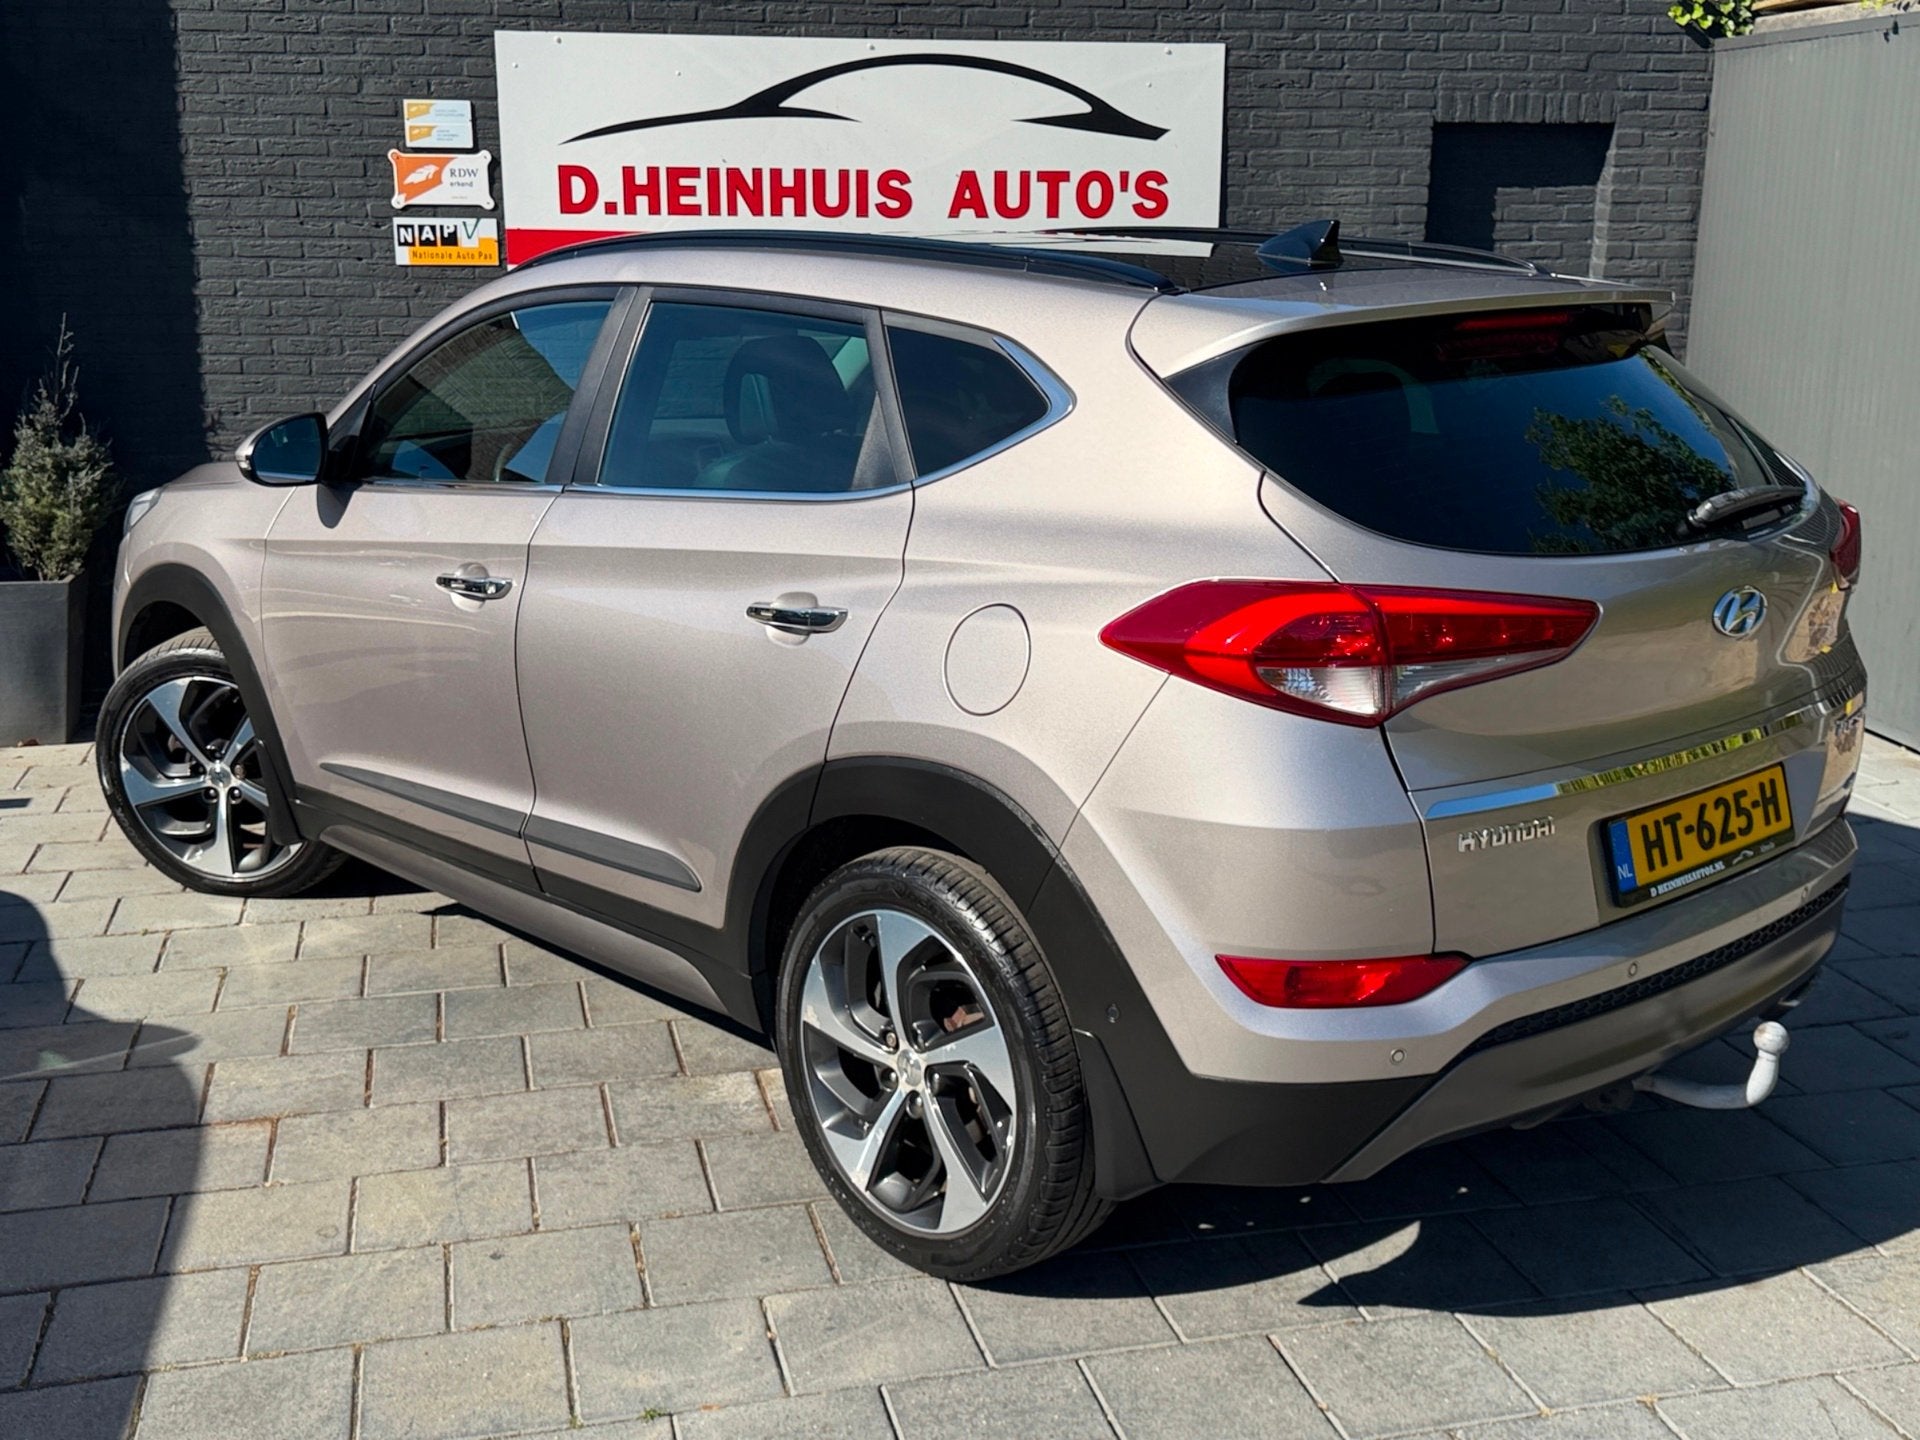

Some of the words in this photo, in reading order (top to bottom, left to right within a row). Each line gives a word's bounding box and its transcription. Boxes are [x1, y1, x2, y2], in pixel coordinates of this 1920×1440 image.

[449, 168, 479, 178] RDW
[557, 164, 913, 219] D.HEINHUIS
[948, 169, 1170, 220] AUTO'S
[412, 250, 453, 260] Nationale
[456, 252, 475, 260] Auto
[478, 252, 493, 260] Pas
[1458, 815, 1556, 853] HYUNDAI
[1641, 778, 1782, 872] HT-625-H
[1617, 864, 1633, 880] NL
